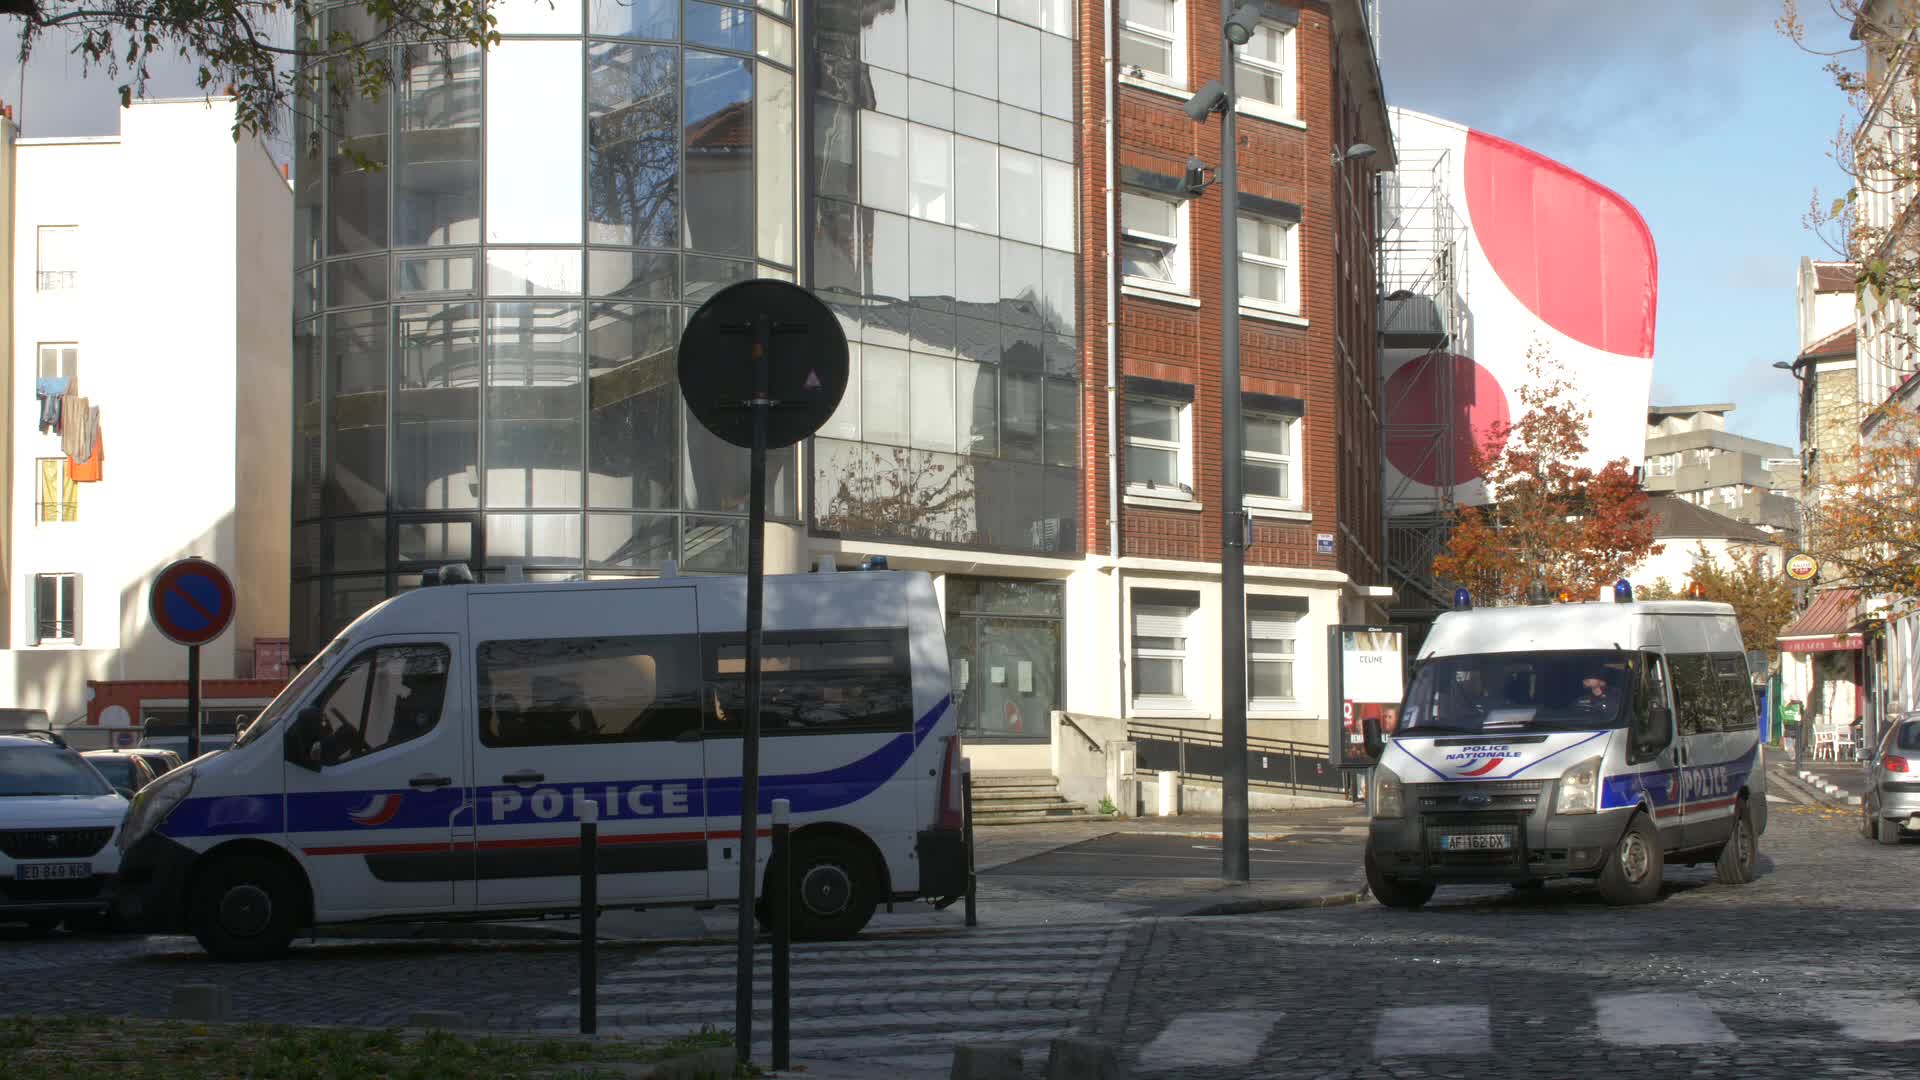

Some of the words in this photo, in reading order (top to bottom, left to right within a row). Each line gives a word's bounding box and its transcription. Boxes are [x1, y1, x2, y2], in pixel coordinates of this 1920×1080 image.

[1360, 656, 1383, 664] CELINE
[1446, 752, 1522, 760] NATIONALE
[1683, 766, 1730, 799] POLICE
[491, 784, 689, 821] POLICE
